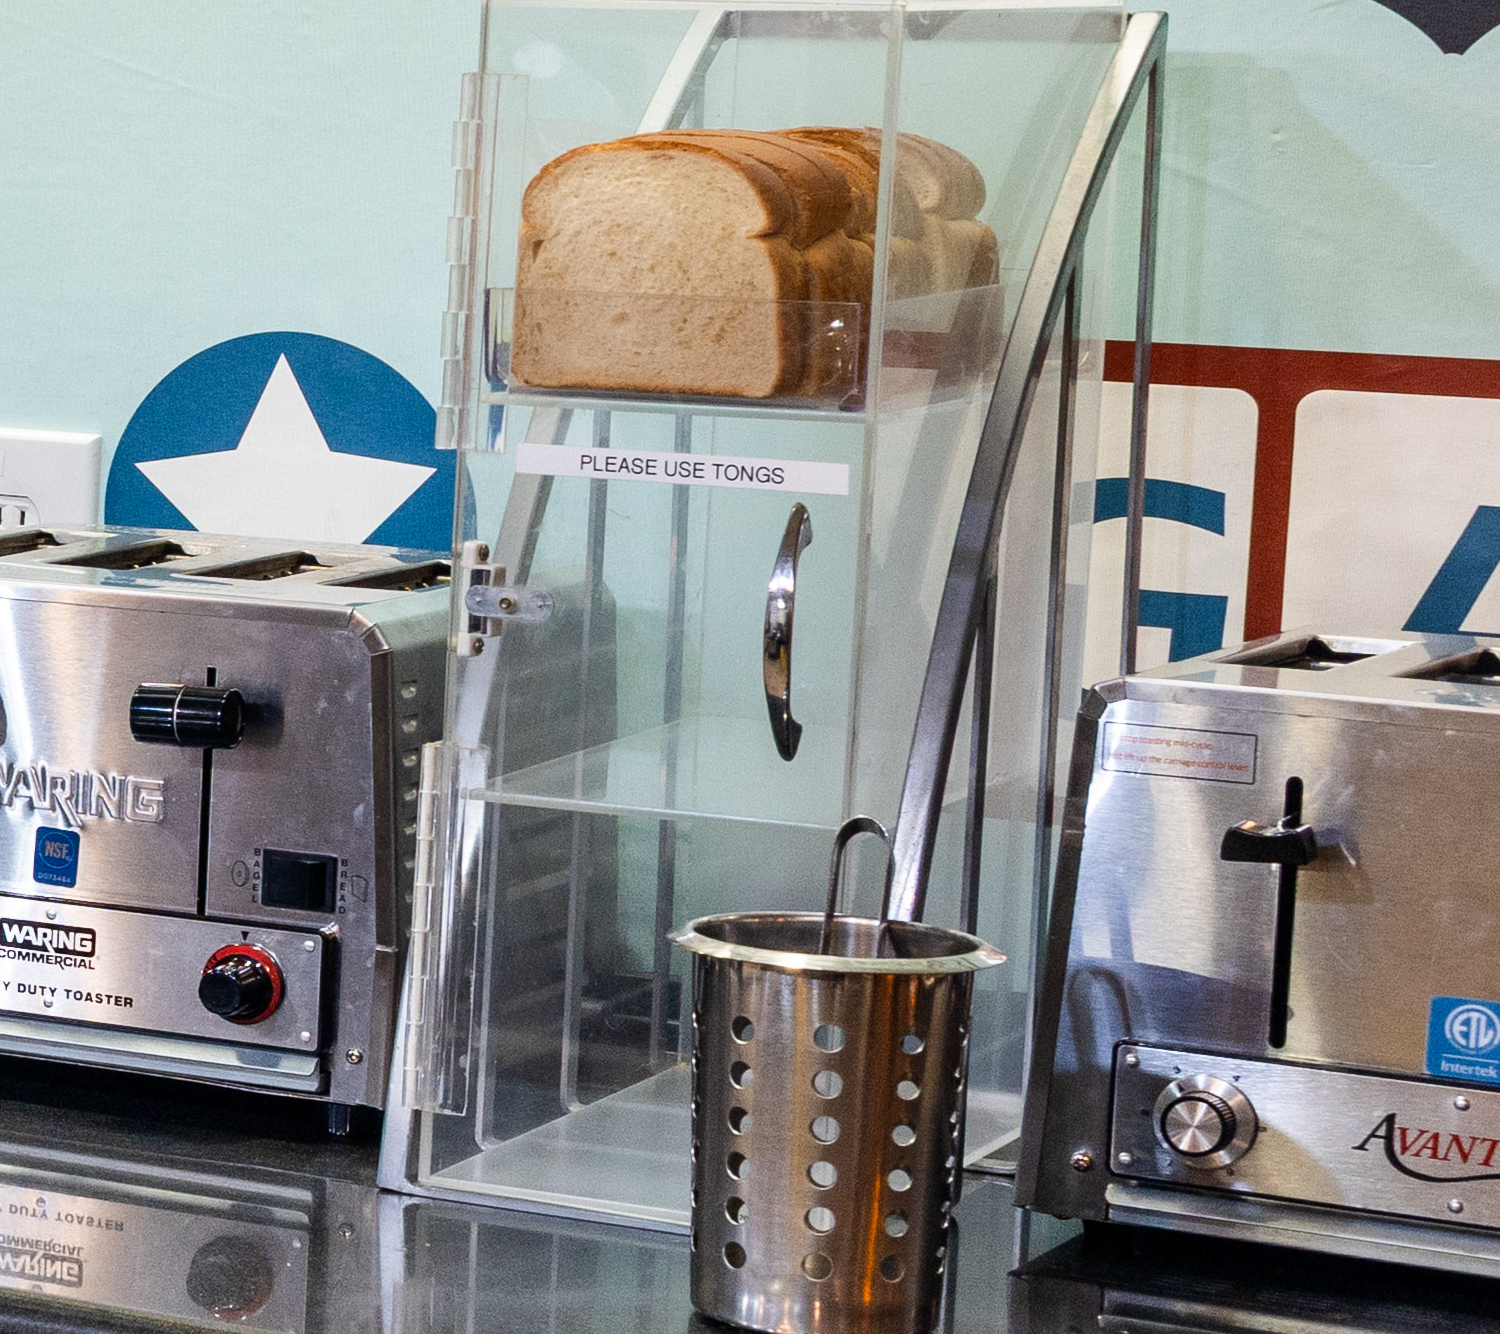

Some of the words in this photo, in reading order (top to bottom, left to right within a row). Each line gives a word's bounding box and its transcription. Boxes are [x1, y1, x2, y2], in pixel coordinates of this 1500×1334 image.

[580, 454, 658, 475] PLEASE
[664, 460, 706, 479] USE
[711, 463, 785, 485] TONGS
[1149, 754, 1161, 763] the
[252, 848, 261, 904] BAGEL
[338, 859, 348, 915] BREAD
[2, 922, 93, 954] WARING
[17, 983, 57, 997] DUTY
[64, 989, 134, 1008] TOASTER
[1441, 1060, 1498, 1078] Intertek
